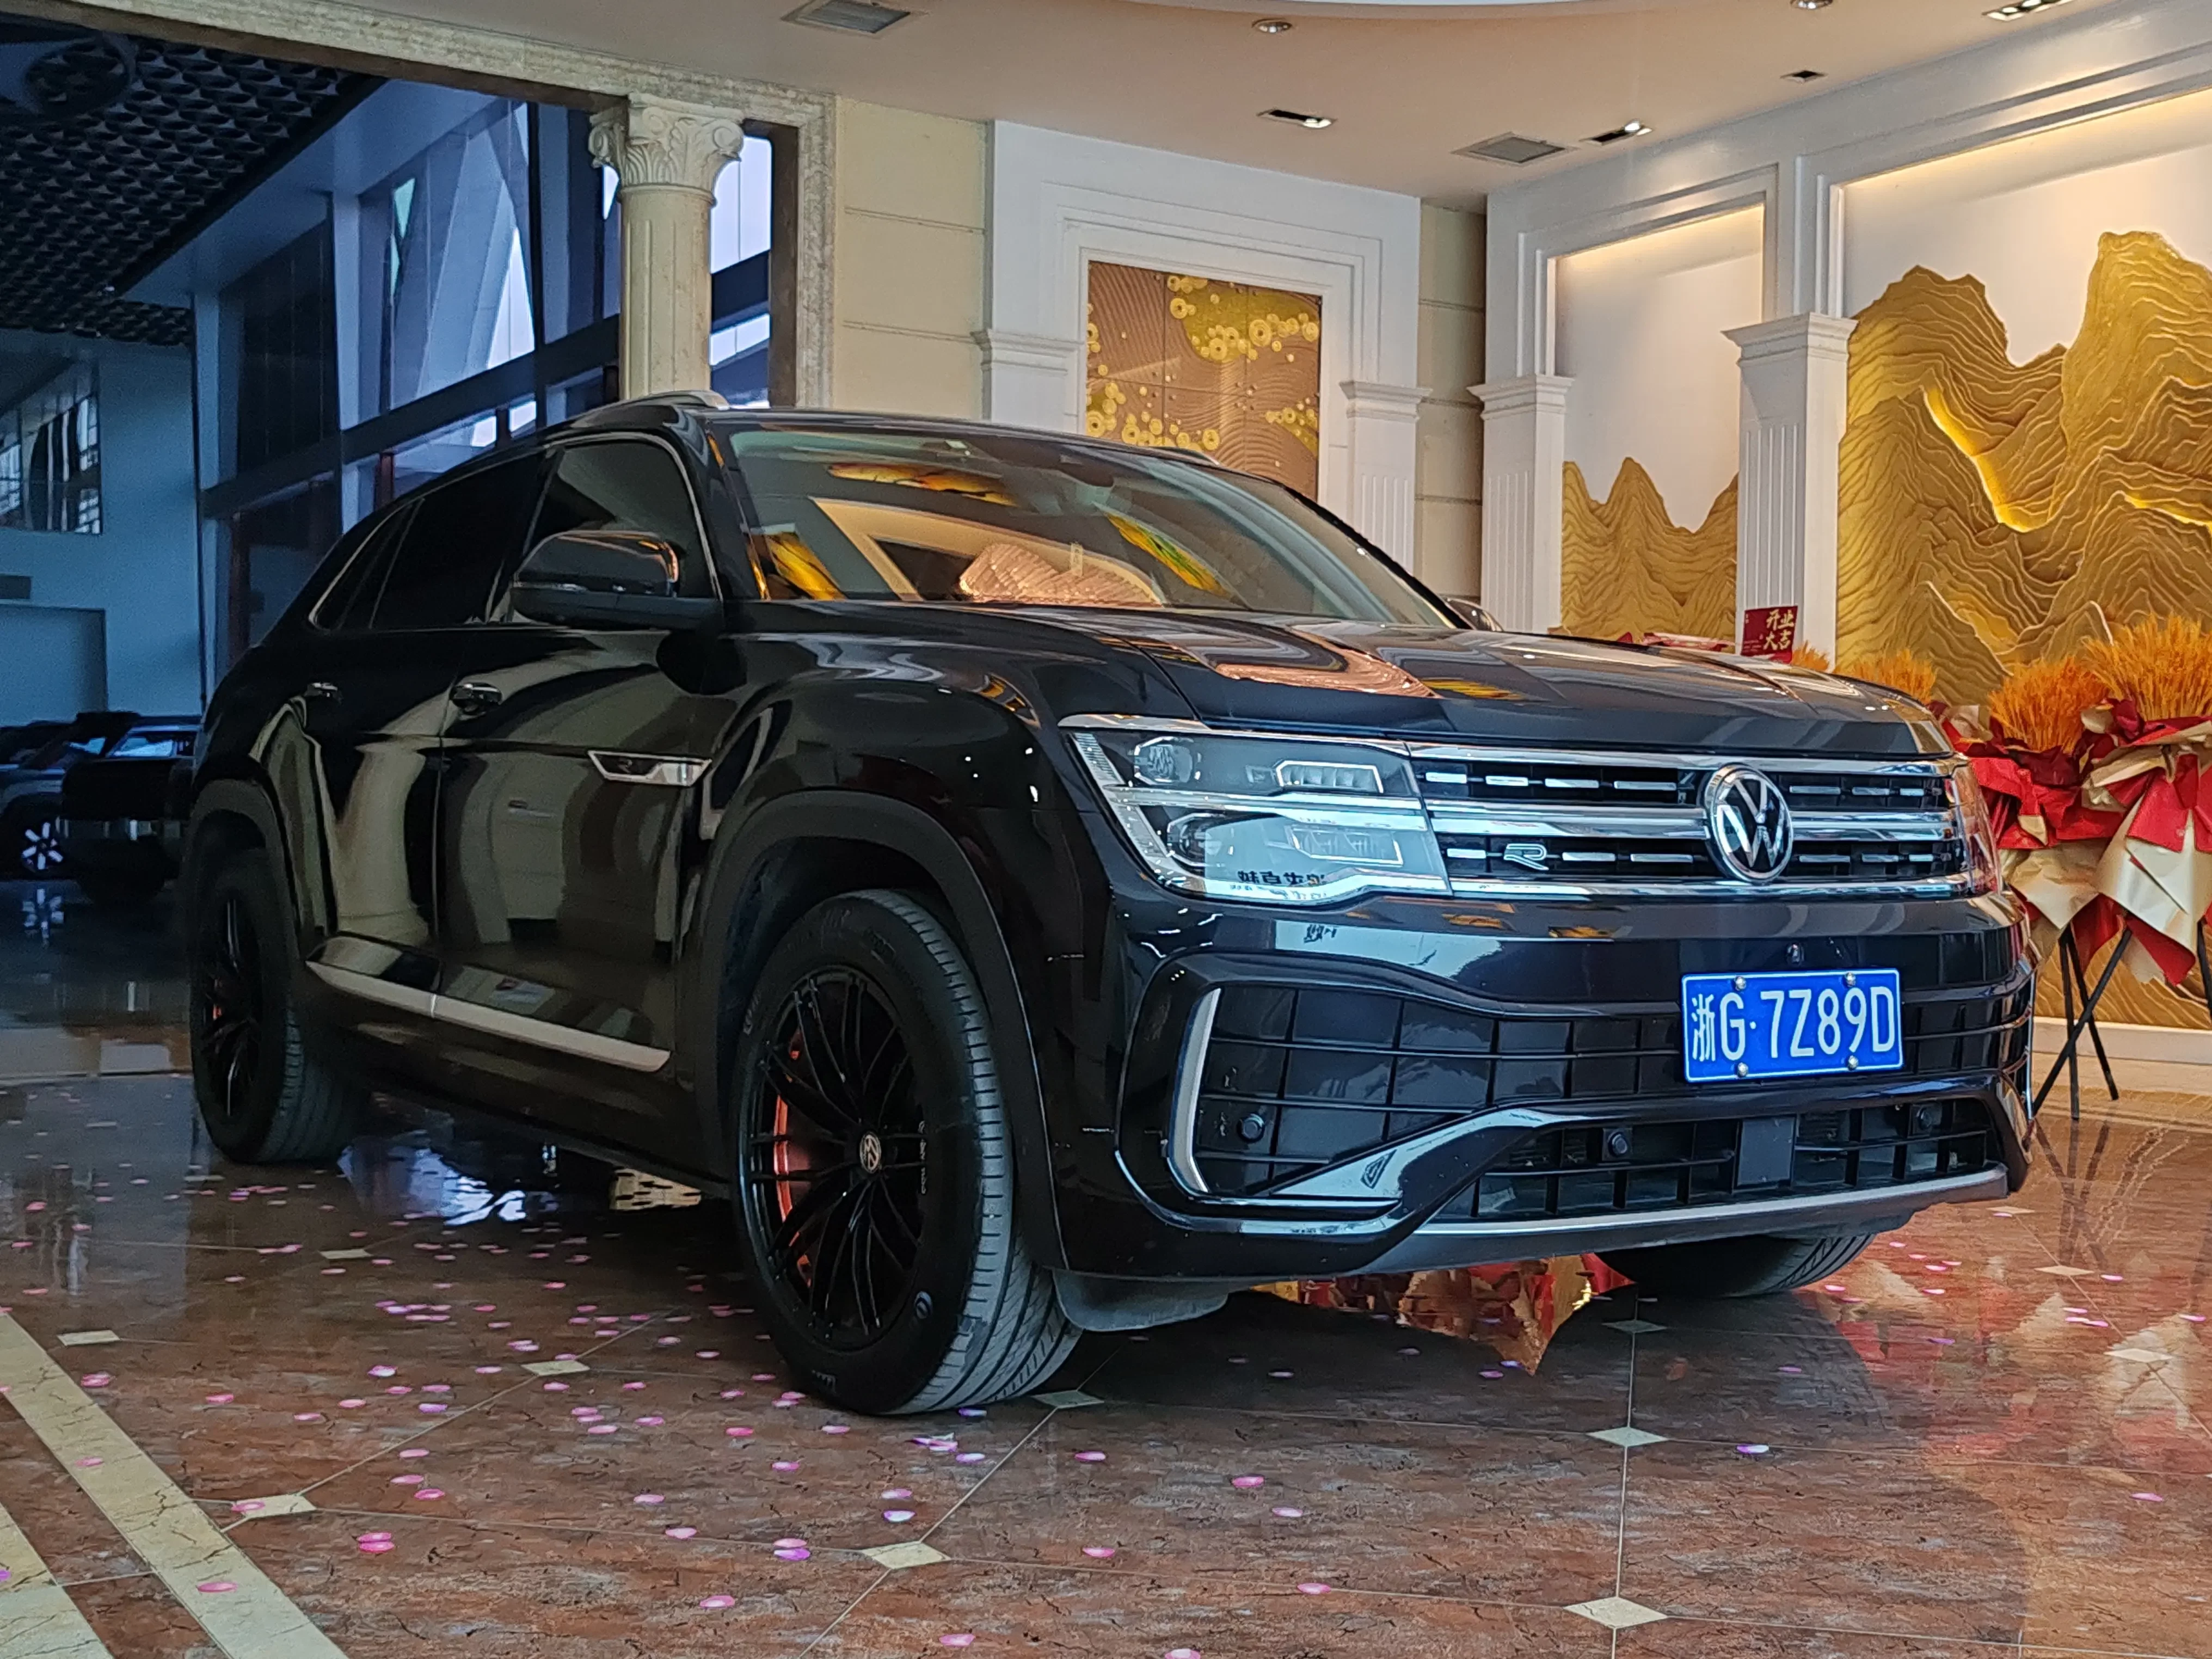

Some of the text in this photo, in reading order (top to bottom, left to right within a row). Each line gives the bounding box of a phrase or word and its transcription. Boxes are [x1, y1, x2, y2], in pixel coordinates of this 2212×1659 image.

[1766, 609, 1795, 631] 开业
[1763, 629, 1792, 650] 大吉
[1503, 843, 1549, 871] R
[1691, 986, 1895, 1062] 浙G·7Z89D
